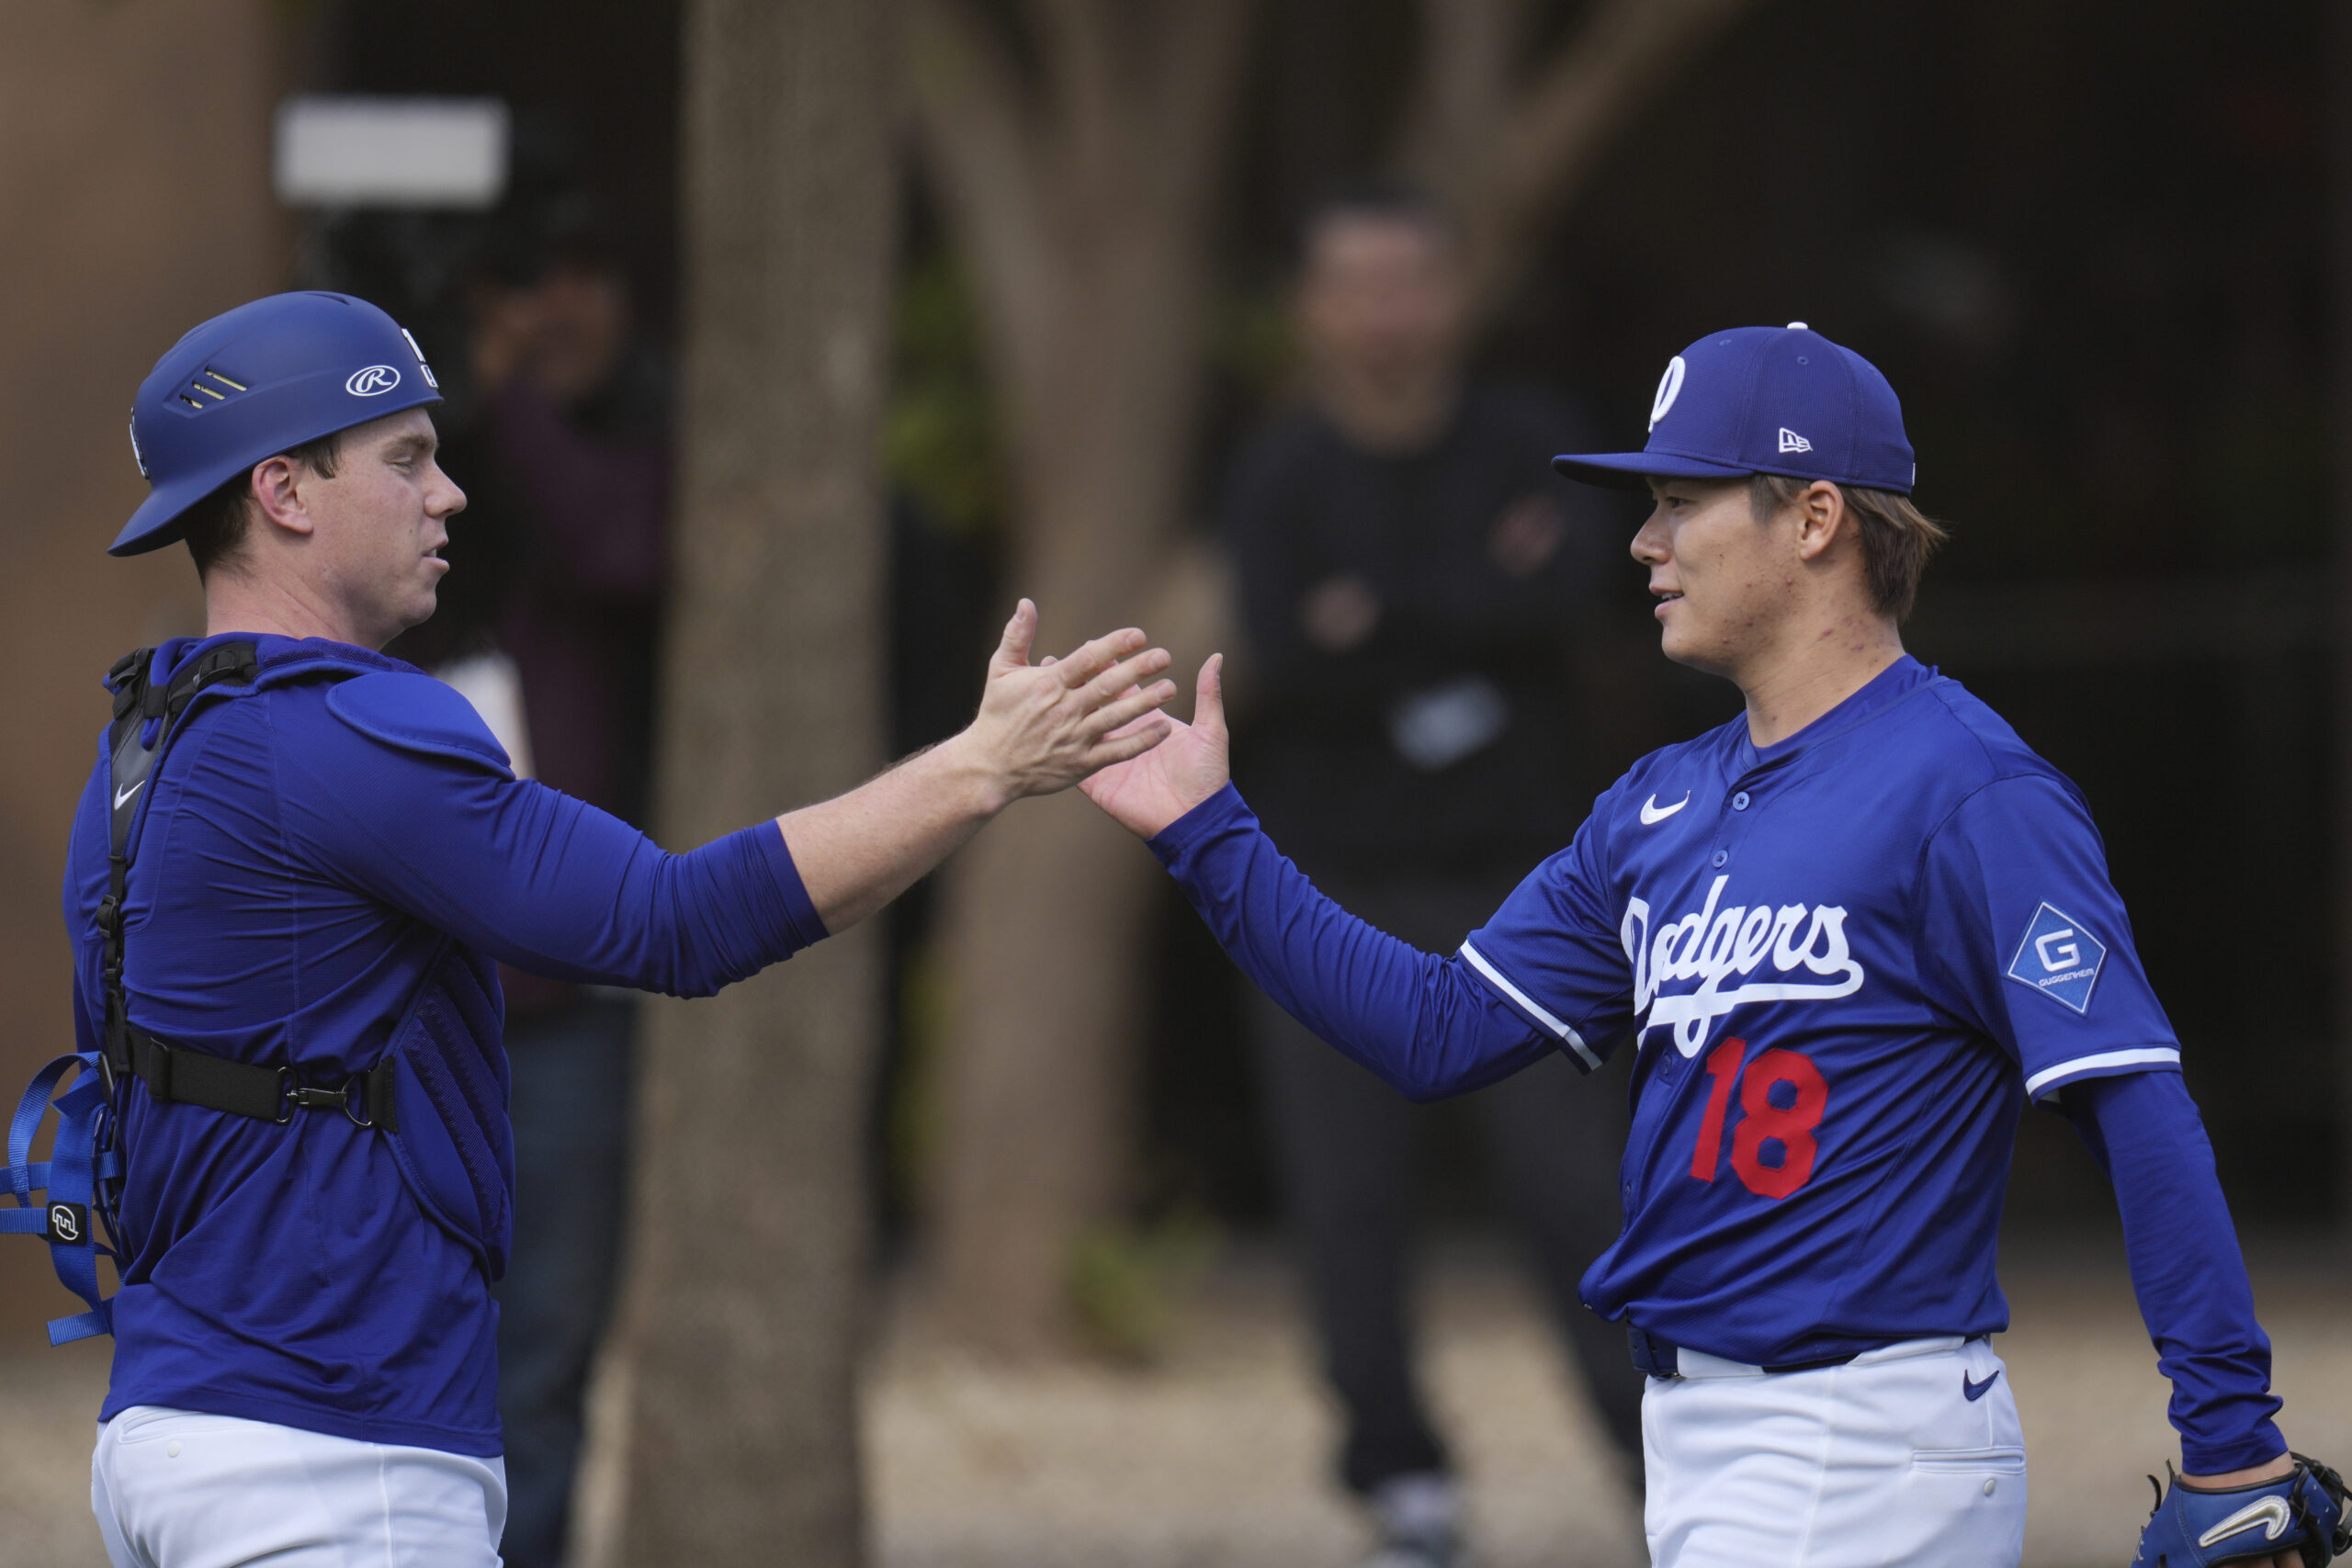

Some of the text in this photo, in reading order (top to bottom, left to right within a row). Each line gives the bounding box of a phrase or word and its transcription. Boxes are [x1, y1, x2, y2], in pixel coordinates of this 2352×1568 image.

[1620, 874, 1865, 1059] Dodgers
[2035, 928, 2081, 972] G
[2038, 967, 2095, 987] GUGGENHEIM
[1689, 1036, 1829, 1201] 18
